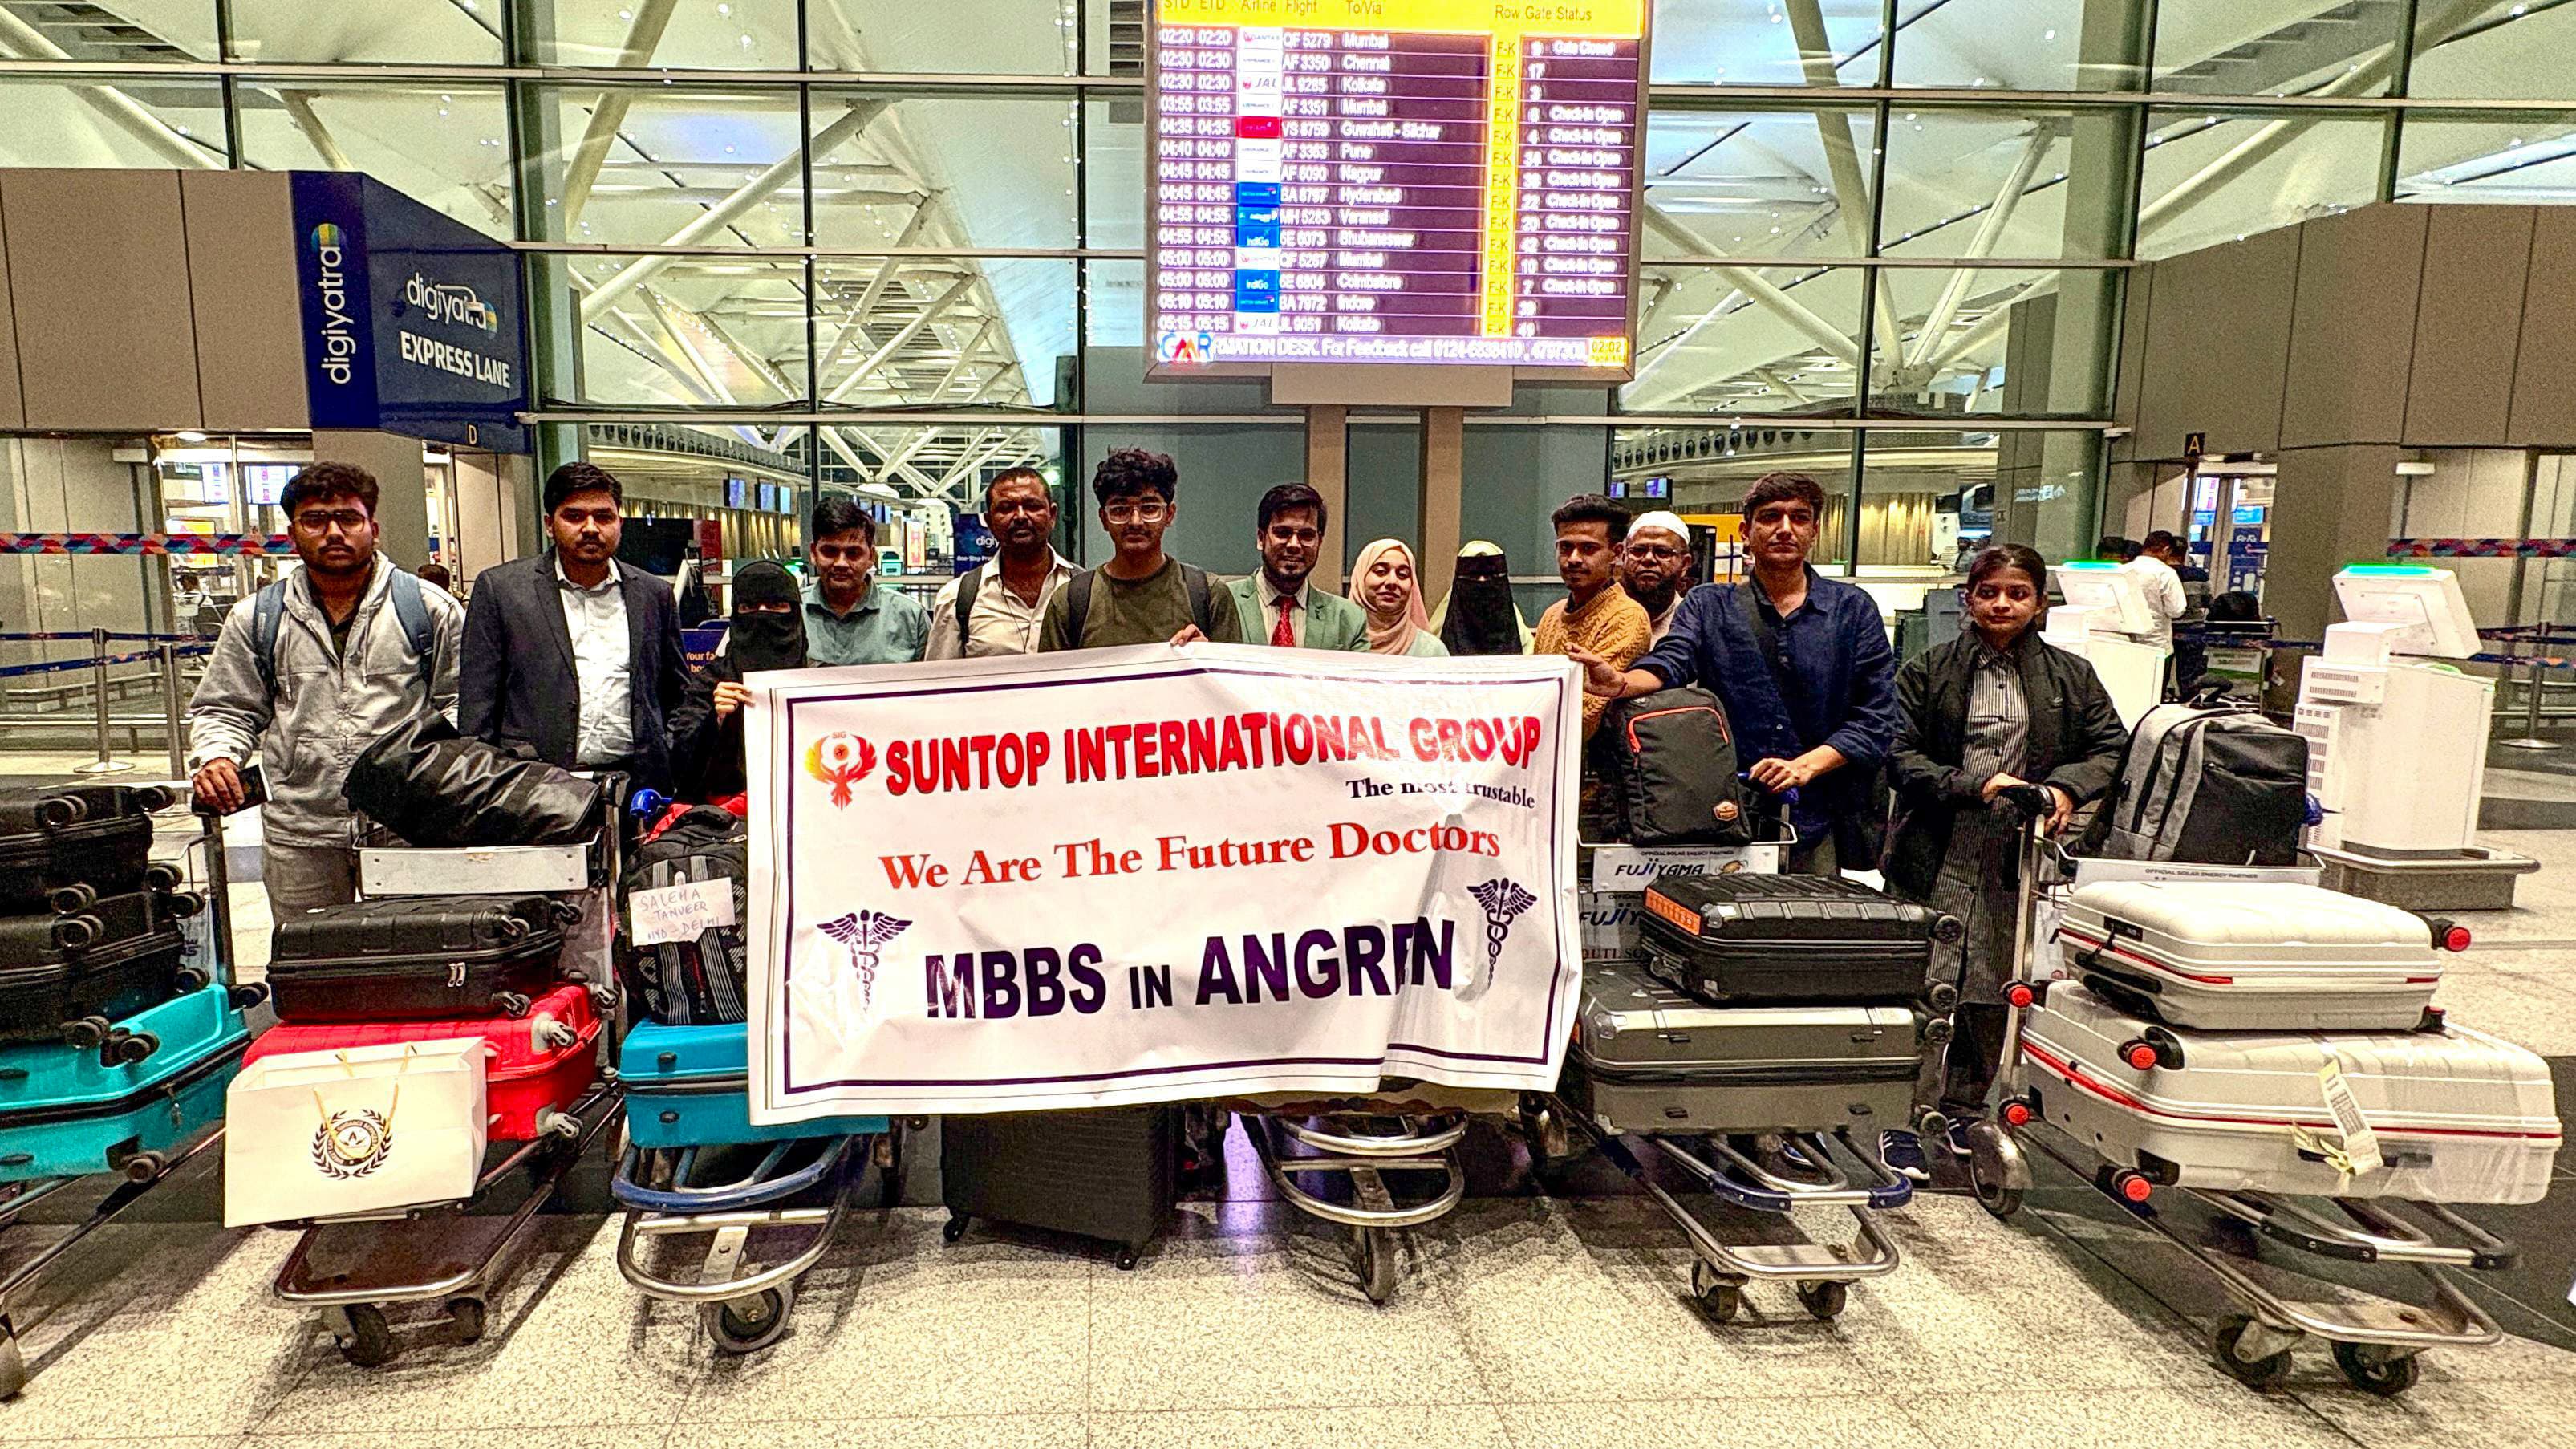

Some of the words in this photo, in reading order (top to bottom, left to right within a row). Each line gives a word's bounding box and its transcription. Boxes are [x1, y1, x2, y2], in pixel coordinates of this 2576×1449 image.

[1241, 0, 1276, 12] Airline
[1286, 0, 1317, 16] Flight
[1346, 0, 1382, 15] To/Via
[1495, 5, 1519, 19] Row
[1525, 6, 1552, 20] Gate
[1557, 6, 1592, 21] Status
[1159, 30, 1194, 43] 02:20
[1198, 30, 1232, 44] 02:20
[1303, 33, 1331, 47] 5279
[1344, 34, 1389, 47] Mumbai
[1497, 42, 1515, 55] F-K
[1554, 42, 1579, 53] Gate
[1161, 51, 1193, 66] 02:30
[1198, 52, 1232, 67] 02:30
[1283, 55, 1299, 69] AF
[1300, 55, 1329, 69] 3350
[1343, 55, 1390, 69] Chennai
[1496, 64, 1515, 77] F-K
[1529, 64, 1544, 79] 17
[1161, 75, 1193, 88] 02:30
[1198, 75, 1230, 89] 02:30
[1256, 78, 1277, 88] JAL
[1283, 77, 1296, 91] JL
[1343, 78, 1385, 91] Kolkata
[1495, 87, 1514, 99] F-K
[1160, 96, 1193, 111] 03:55
[1198, 97, 1230, 112] 03:55
[1281, 99, 1298, 113] AF
[1342, 100, 1387, 114] Mumbai
[1495, 109, 1513, 121] F-K
[1595, 108, 1622, 121] Open
[1160, 119, 1193, 132] 04:35
[1197, 120, 1230, 134] 04:35
[1282, 122, 1299, 136] VS
[1300, 123, 1329, 136] 8759
[1341, 123, 1393, 136] Guwahati
[1494, 131, 1512, 143] F-K
[1593, 130, 1621, 144] Open
[1160, 141, 1193, 156] 04:40
[1197, 142, 1230, 156] 04:40
[1281, 144, 1297, 157] AF
[1341, 144, 1371, 157] Pune
[1493, 152, 1511, 164] F-K
[1592, 152, 1621, 168] Open
[1160, 164, 1193, 177] 04:45
[1197, 164, 1229, 178] 04:45
[1281, 166, 1297, 180] AF
[1341, 166, 1381, 182] Nagpur
[1492, 174, 1510, 185] F-K
[1592, 173, 1619, 186] Open
[1160, 185, 1193, 199] 04:45
[1197, 186, 1229, 200] 04:45
[1341, 189, 1400, 202] Hyderabad
[1491, 196, 1509, 207] F-K
[1591, 195, 1618, 209] Open
[1159, 207, 1193, 221] 04:55
[1196, 208, 1229, 221] 04:55
[1280, 209, 1300, 223] MH
[1340, 211, 1389, 223] Varanasi
[1491, 217, 1508, 228] F-K
[1590, 217, 1617, 229] Open
[1159, 229, 1191, 243] 04:55
[1196, 229, 1229, 244] 04:55
[1247, 236, 1269, 246] IndiGo
[1490, 239, 1507, 250] F-K
[1588, 237, 1616, 254] Open
[1159, 250, 1192, 265] 05:00
[1196, 252, 1228, 265] 05:00
[1339, 253, 1383, 266] Mumbai
[1489, 261, 1507, 272] F-K
[1522, 260, 1537, 274] 10
[1588, 259, 1615, 271] Open
[1157, 273, 1191, 286] 05:00
[1195, 273, 1228, 286] 05:00
[1246, 280, 1268, 290] IndiGo
[1488, 282, 1506, 293] F-K
[1587, 280, 1614, 293] Open
[318, 246, 356, 384] digiyatra
[1159, 294, 1191, 308] 05:10
[1195, 294, 1229, 308] 05:10
[1487, 303, 1505, 315] F-K
[1487, 324, 1504, 334] F-K
[1161, 332, 1213, 361] GMR
[400, 331, 473, 377] EXPRESS
[475, 354, 511, 388] LANE
[469, 424, 477, 444] D
[2187, 435, 2200, 454] A
[976, 536, 1000, 548] digiy
[832, 731, 847, 739] SIG
[886, 731, 1050, 796] SUNTOP
[1064, 712, 1401, 784] INTERNATIONAL
[1409, 716, 1540, 769] GROUP
[1345, 777, 1393, 798] The
[878, 854, 949, 889] We
[960, 850, 1042, 885] Are
[1053, 838, 1143, 878] The
[1156, 834, 1315, 871] Future
[1327, 821, 1500, 858] Doctors
[1614, 858, 1705, 877] FUJIYAMA
[654, 900, 708, 921] TANVEER
[1579, 903, 1641, 927] FUJIY
[679, 916, 720, 936] DELHI
[925, 943, 1106, 1019] MBBS
[1129, 964, 1173, 1009] IN
